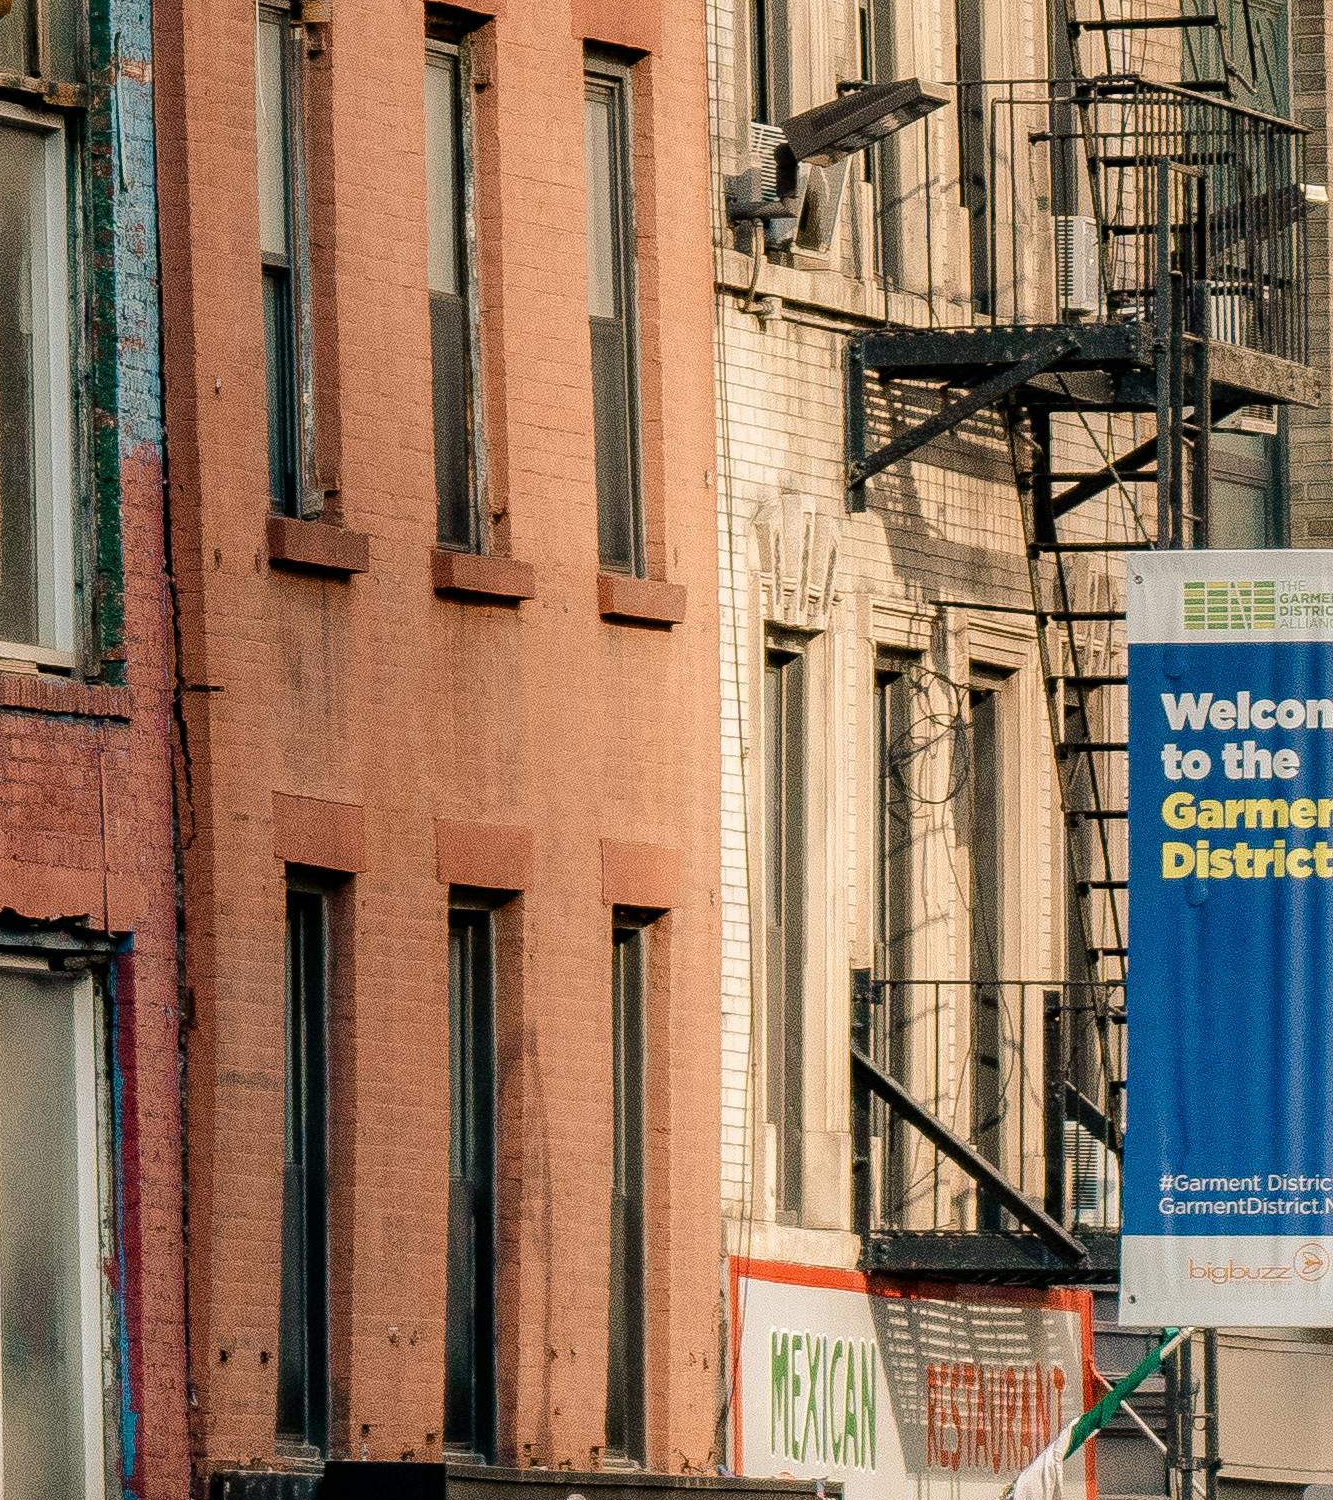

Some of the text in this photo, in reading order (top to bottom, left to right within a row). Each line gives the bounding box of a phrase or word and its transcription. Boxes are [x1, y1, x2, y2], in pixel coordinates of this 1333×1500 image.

[1160, 740, 1300, 780] to the
[1159, 1174, 1263, 1192] #Garment
[1188, 1257, 1293, 1286] bigbuzz
[770, 1328, 877, 1474] MEXICAN
